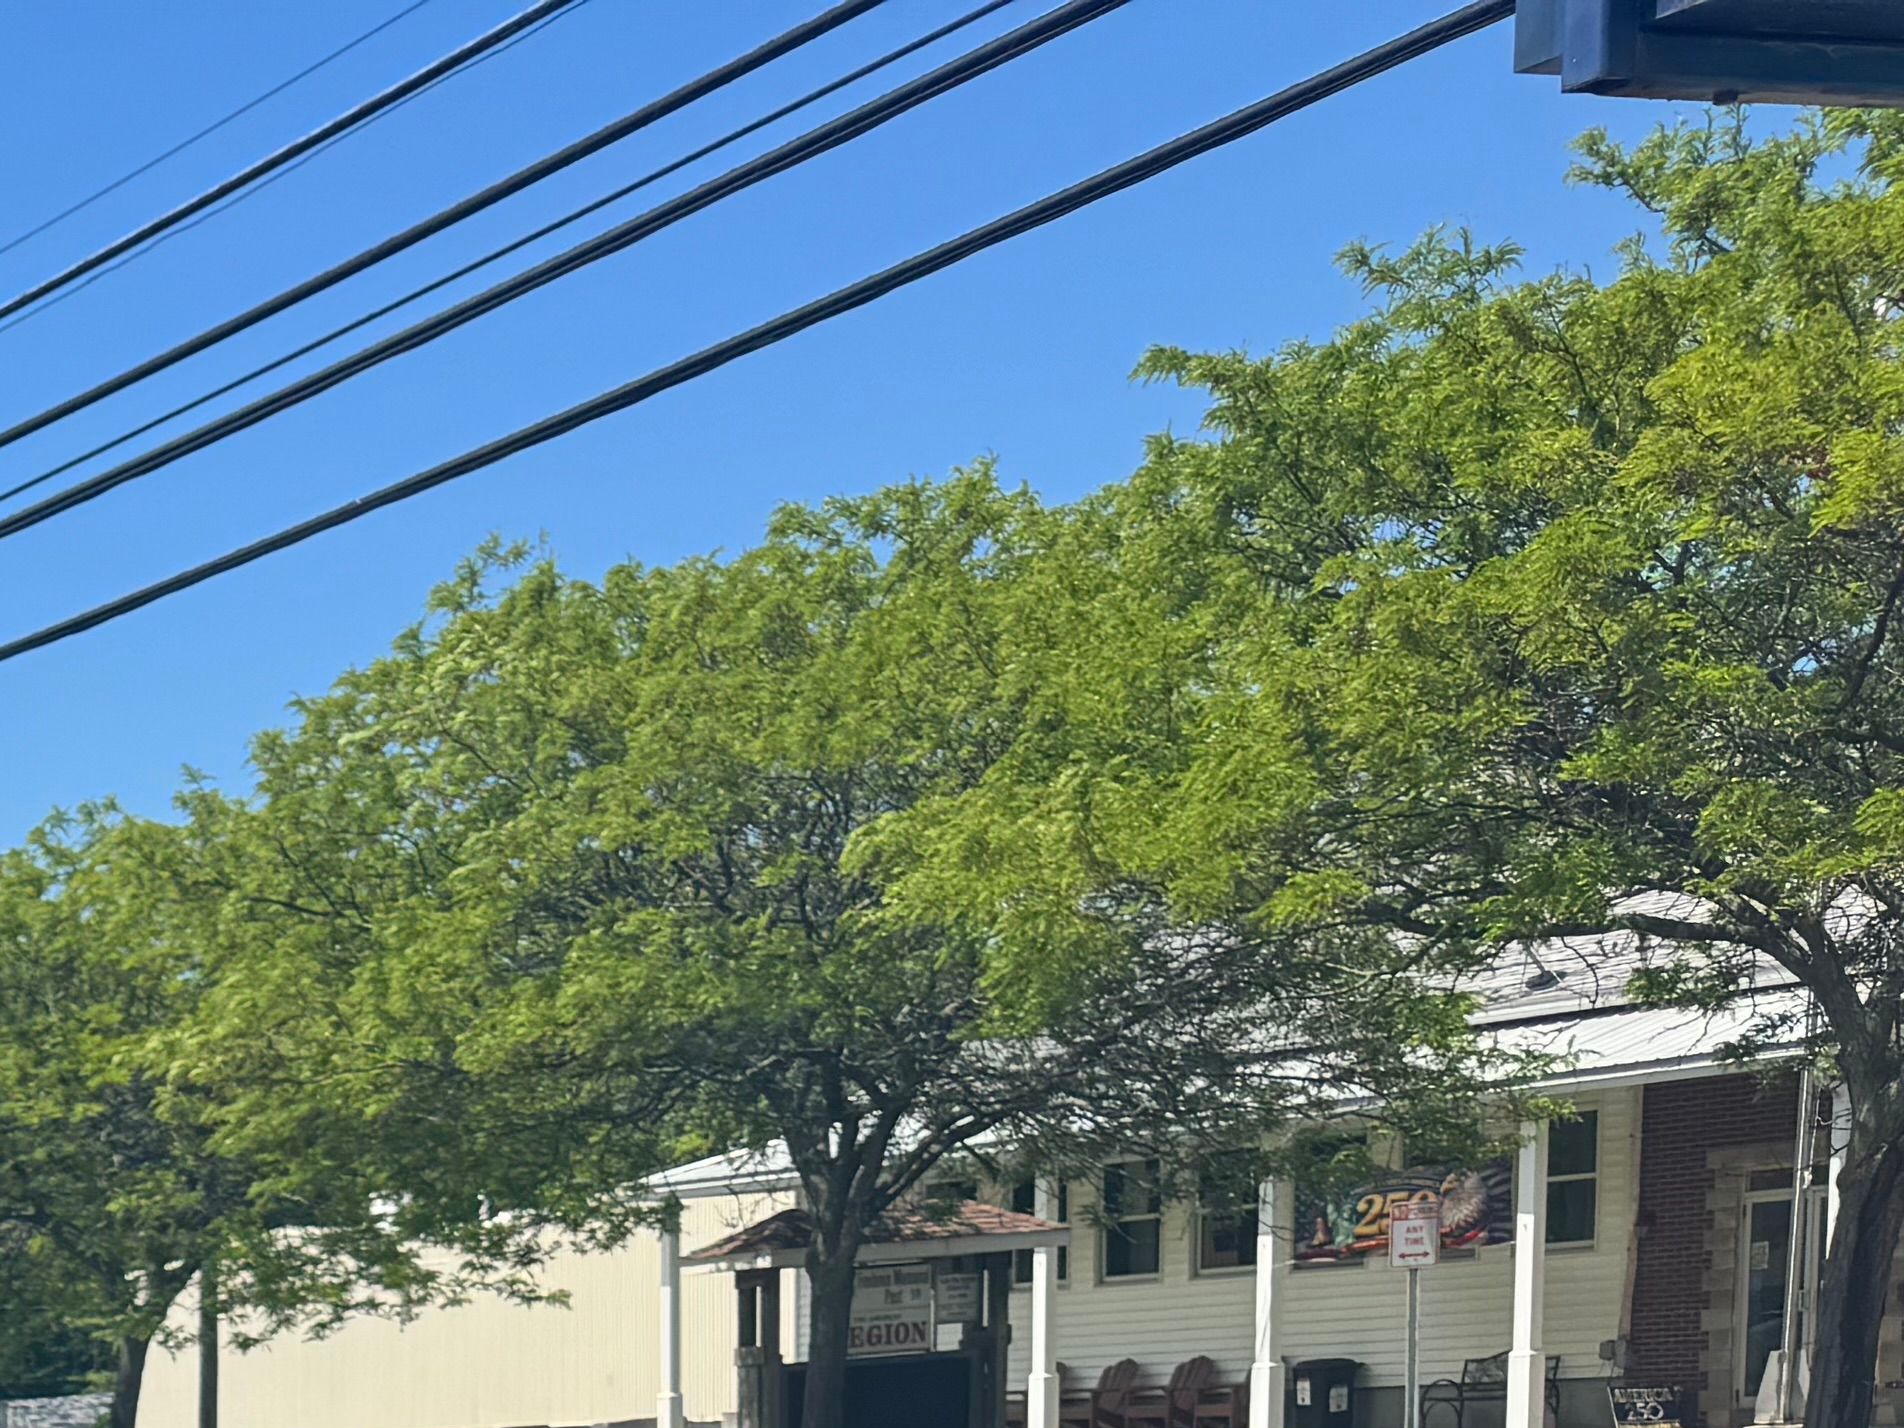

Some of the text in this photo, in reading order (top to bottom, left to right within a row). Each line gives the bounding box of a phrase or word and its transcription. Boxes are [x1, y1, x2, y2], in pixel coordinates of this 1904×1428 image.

[1406, 1226, 1424, 1234] ANY
[1405, 1237, 1425, 1246] TIME
[848, 1321, 927, 1348] EGION
[1625, 1402, 1664, 1420] 250
